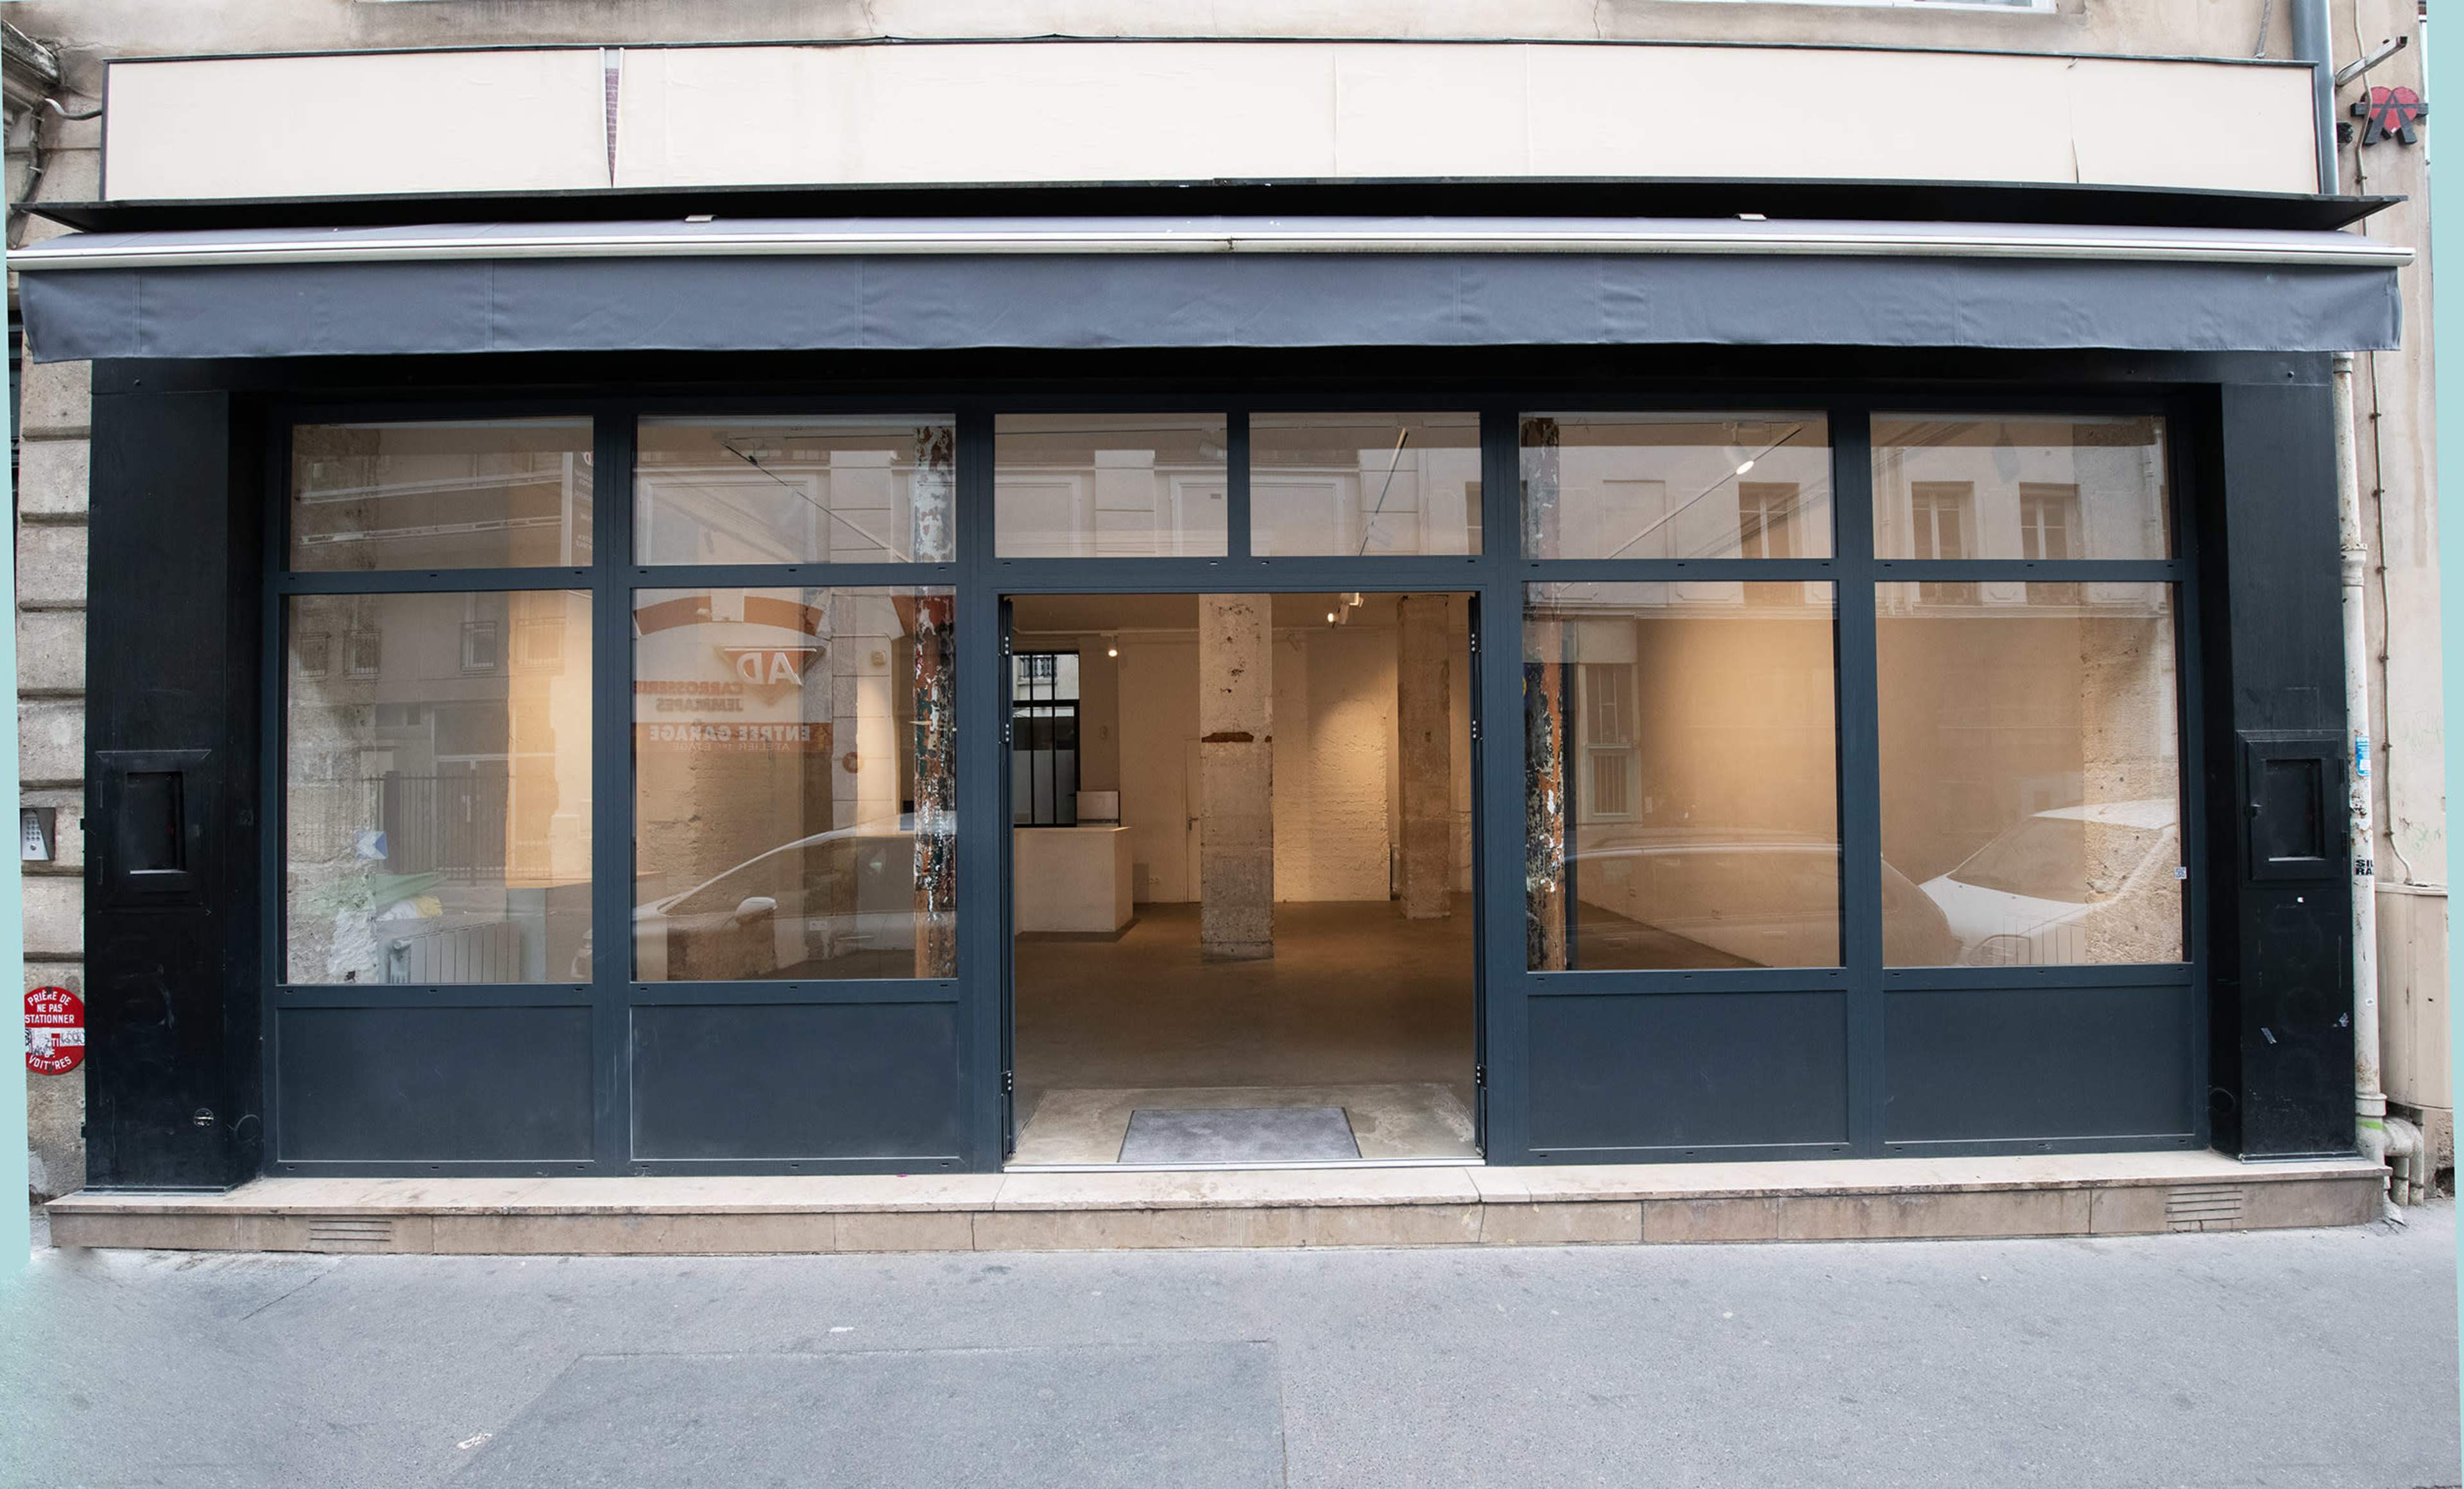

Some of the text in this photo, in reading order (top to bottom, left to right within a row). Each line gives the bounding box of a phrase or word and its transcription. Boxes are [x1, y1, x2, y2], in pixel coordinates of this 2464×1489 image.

[59, 993, 72, 1006] DE
[37, 1003, 63, 1012] NE PAS
[25, 1014, 74, 1023] STATIONNER
